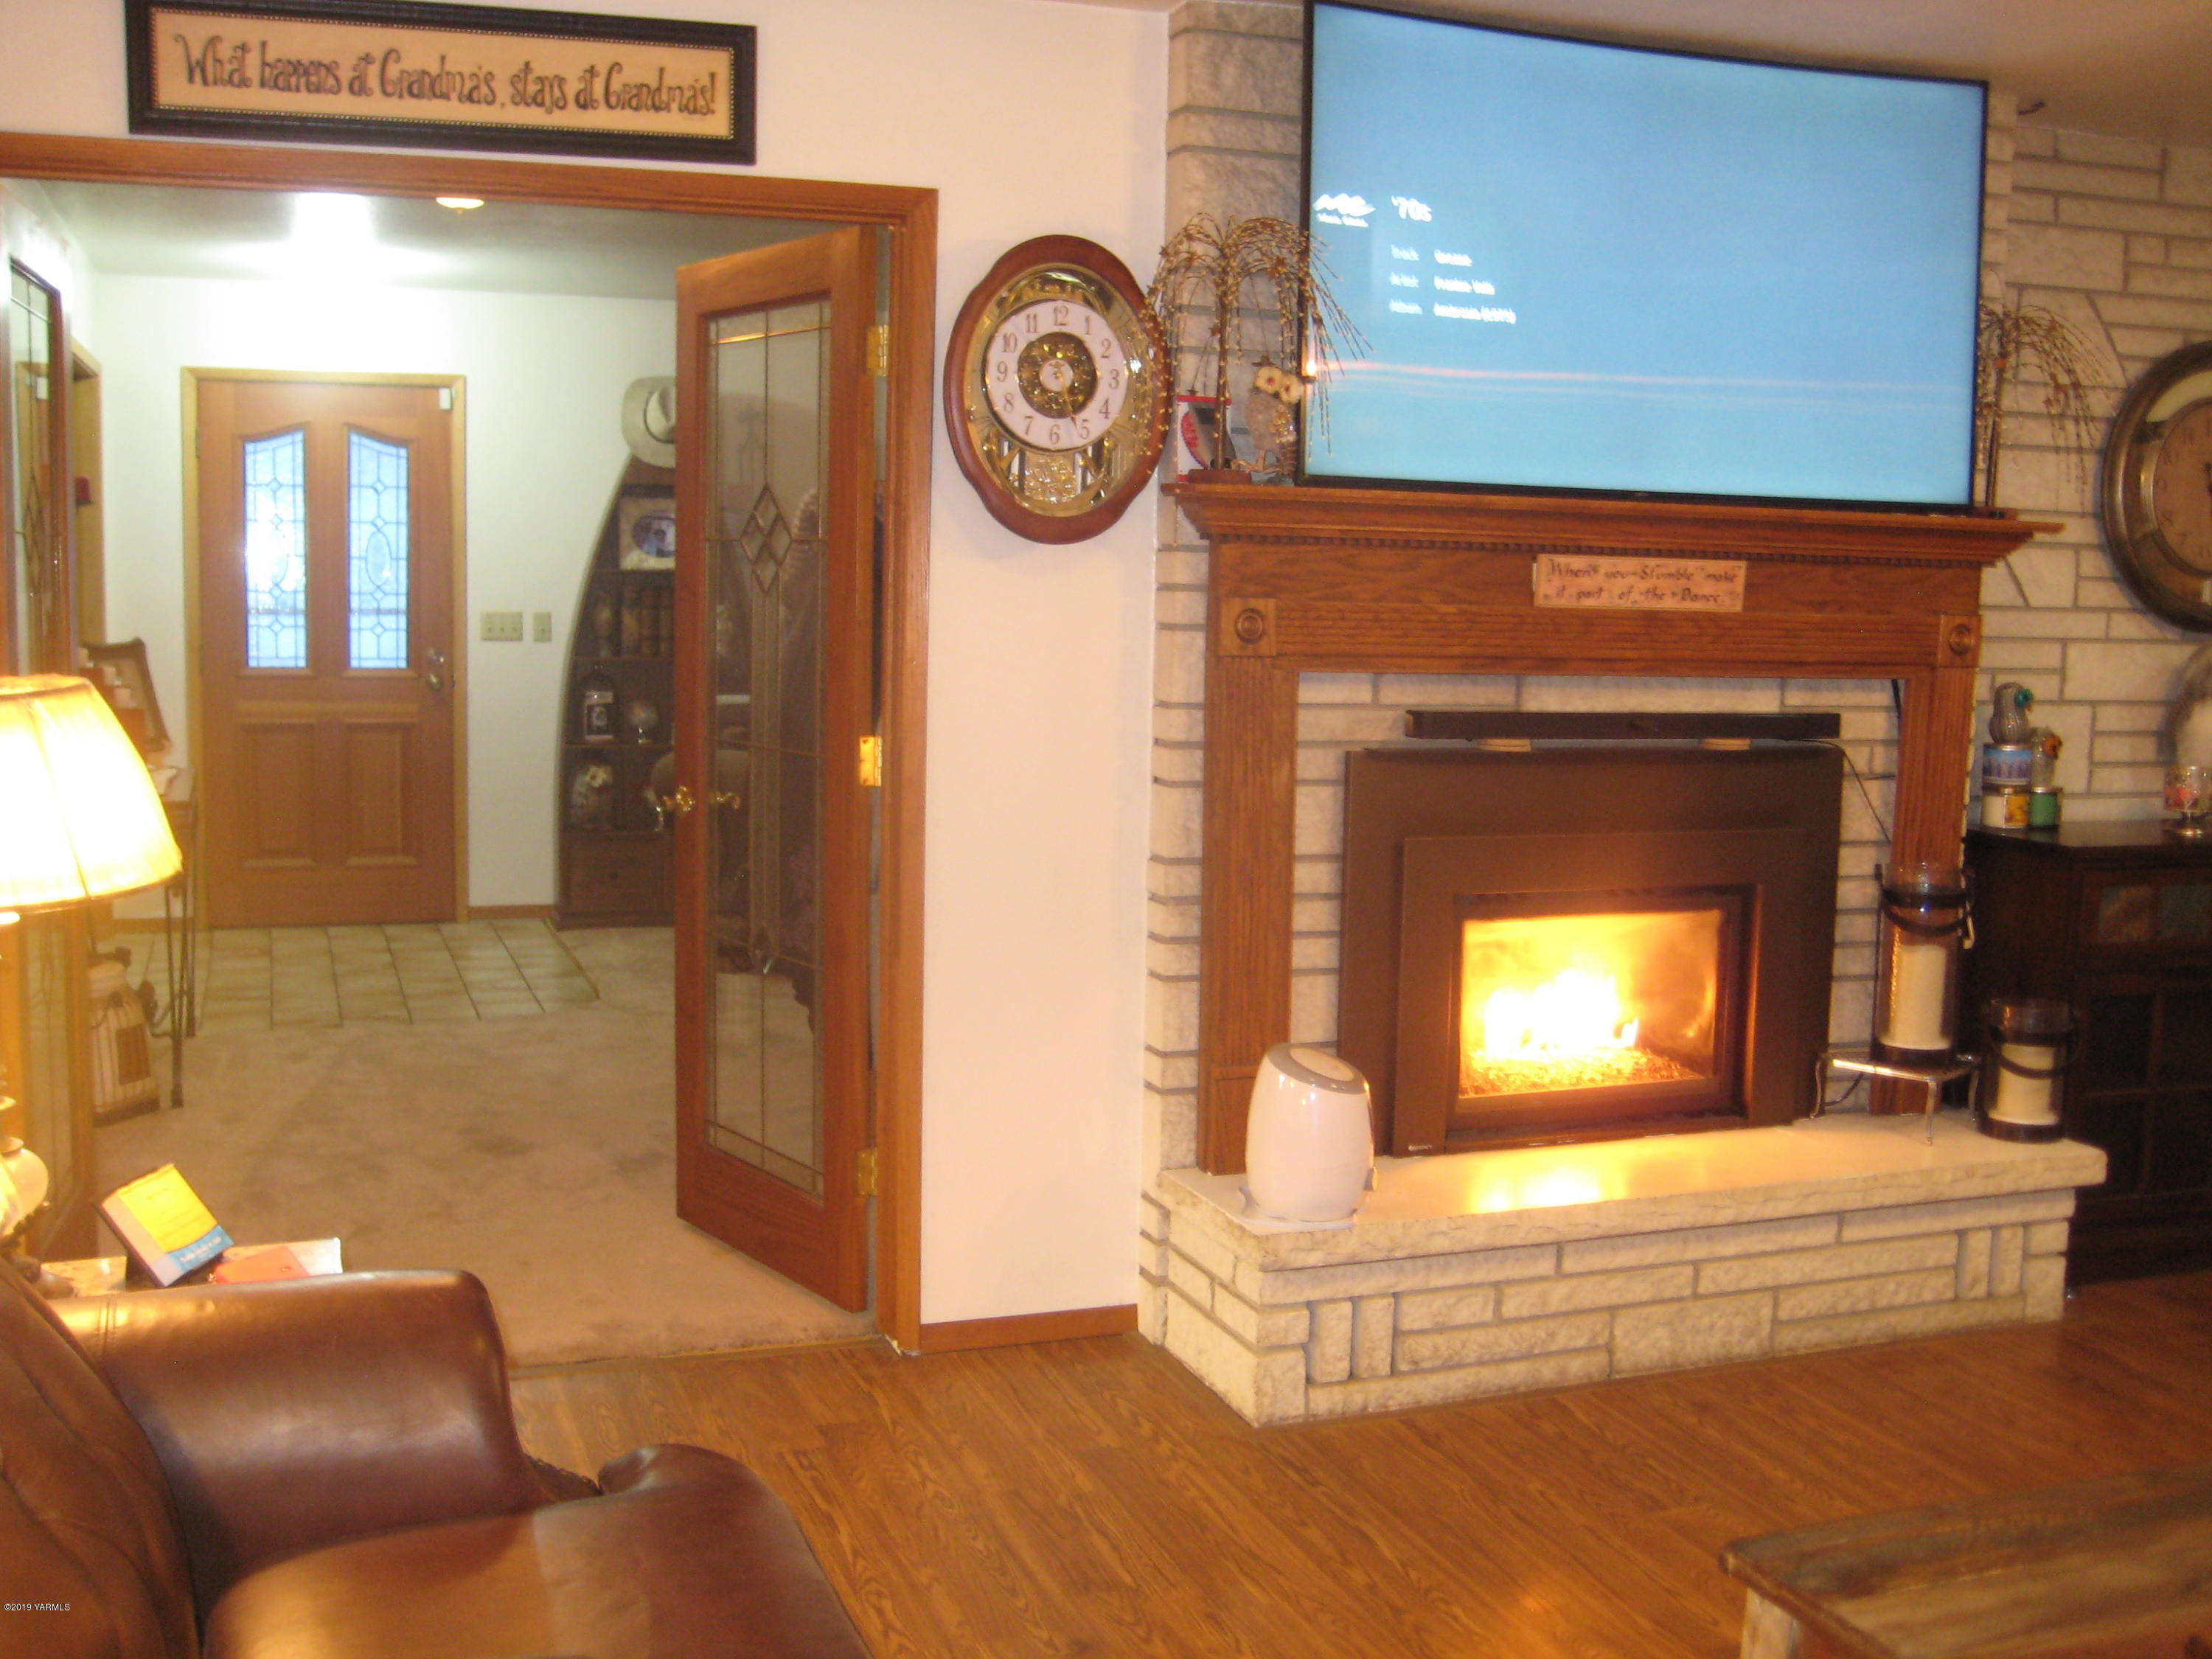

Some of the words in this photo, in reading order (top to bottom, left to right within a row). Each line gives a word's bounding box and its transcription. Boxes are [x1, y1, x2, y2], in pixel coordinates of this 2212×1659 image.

[174, 33, 252, 88] What
[259, 39, 341, 96] happens
[348, 52, 376, 97] at
[509, 60, 568, 114] stays
[574, 64, 601, 110] at
[604, 61, 717, 116] Grandma's!
[1026, 313, 1039, 333] 11
[1053, 305, 1068, 326] 12
[1085, 315, 1091, 335] 1
[1002, 333, 1018, 353] 10
[1101, 338, 1112, 359] 2
[997, 361, 1009, 382] 9
[1108, 369, 1120, 389] 3
[1004, 392, 1015, 414] 8
[1099, 398, 1110, 419] 4
[1023, 415, 1035, 435] 7
[1049, 423, 1060, 444] 6
[1080, 419, 1091, 440] 5
